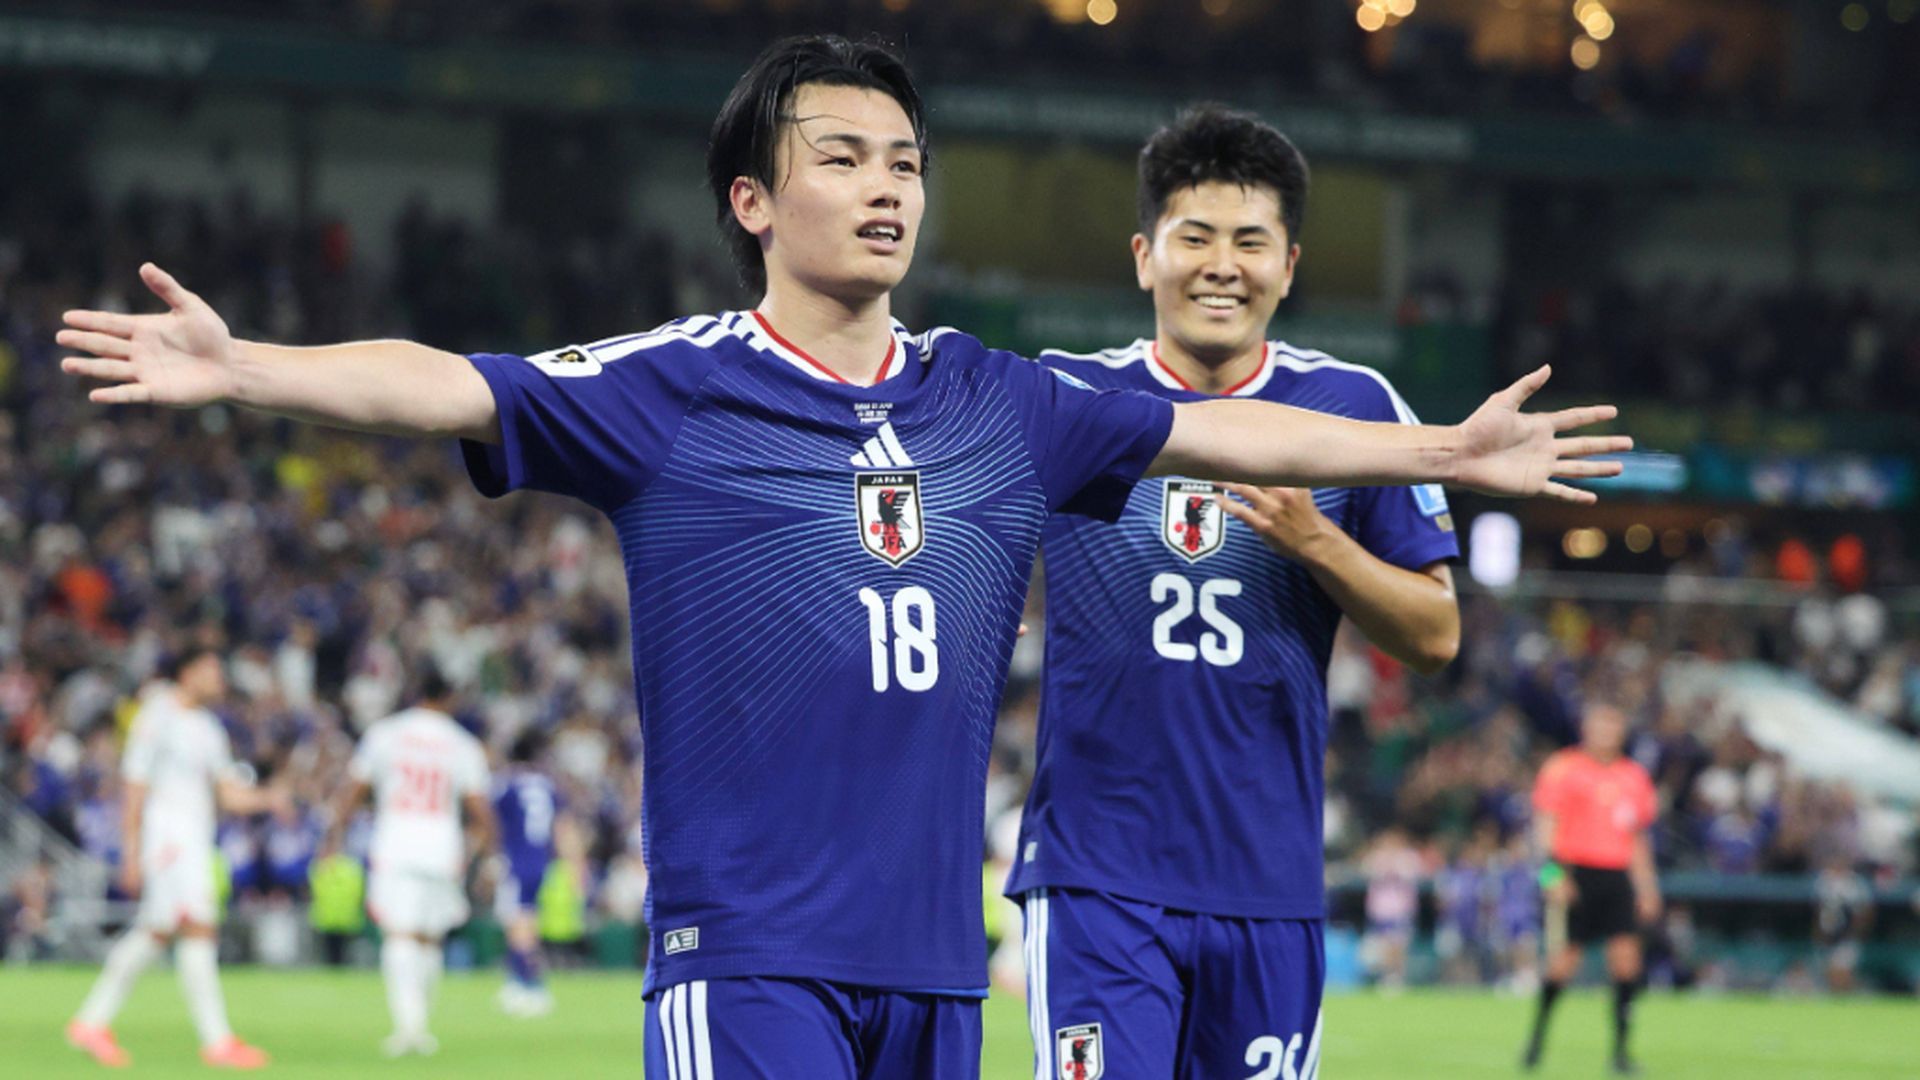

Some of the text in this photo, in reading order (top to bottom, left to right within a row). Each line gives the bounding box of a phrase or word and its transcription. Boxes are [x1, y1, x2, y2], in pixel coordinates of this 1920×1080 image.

[871, 476, 904, 485] JAPAN
[879, 535, 907, 550] JFA
[858, 585, 940, 694] 18
[1151, 572, 1244, 666] 25
